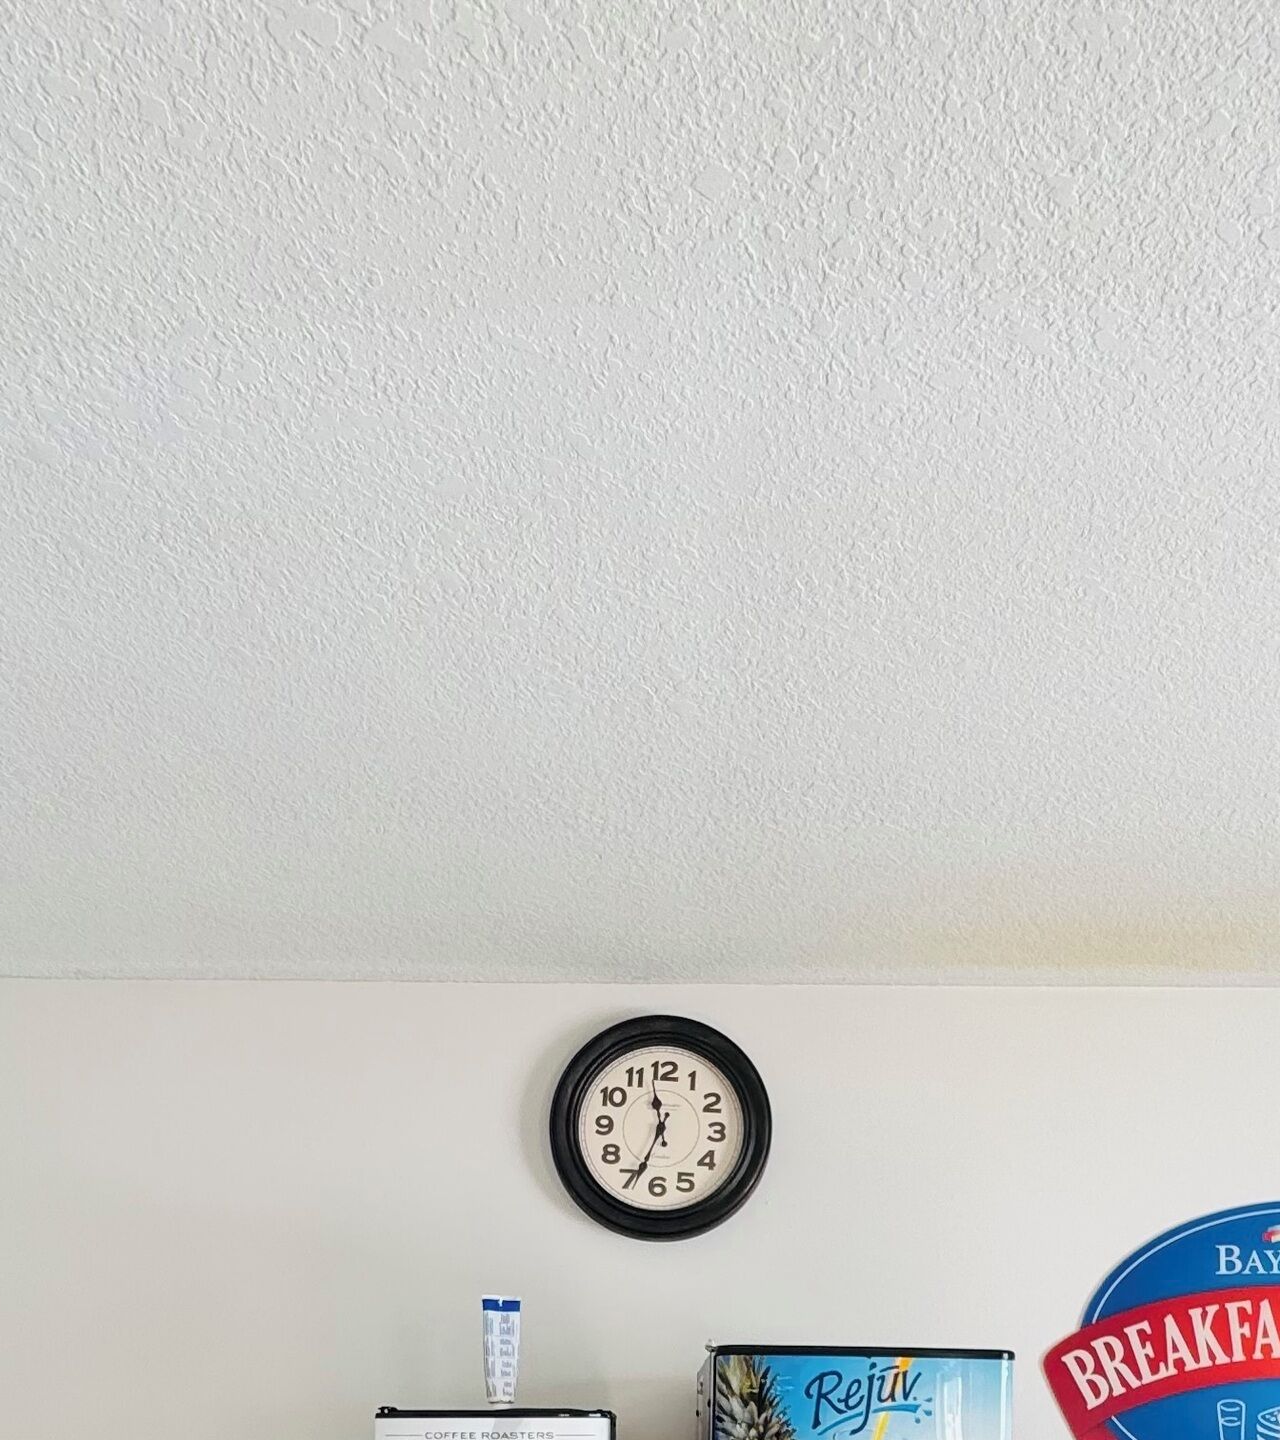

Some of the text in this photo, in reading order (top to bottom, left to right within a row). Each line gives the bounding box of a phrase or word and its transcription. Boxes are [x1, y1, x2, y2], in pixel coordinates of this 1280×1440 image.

[625, 1066, 645, 1088] 11
[650, 1060, 679, 1082] 12
[687, 1070, 697, 1091] 1
[599, 1086, 627, 1107] 10
[702, 1092, 722, 1114] 2
[594, 1115, 614, 1136] 9
[706, 1122, 726, 1142] 3
[601, 1143, 621, 1164] 8
[696, 1150, 717, 1171] 4
[619, 1168, 640, 1190] 7
[648, 1176, 667, 1197] 6
[676, 1172, 695, 1192] 5
[424, 1431, 554, 1440] COFFEE ROASTERS
